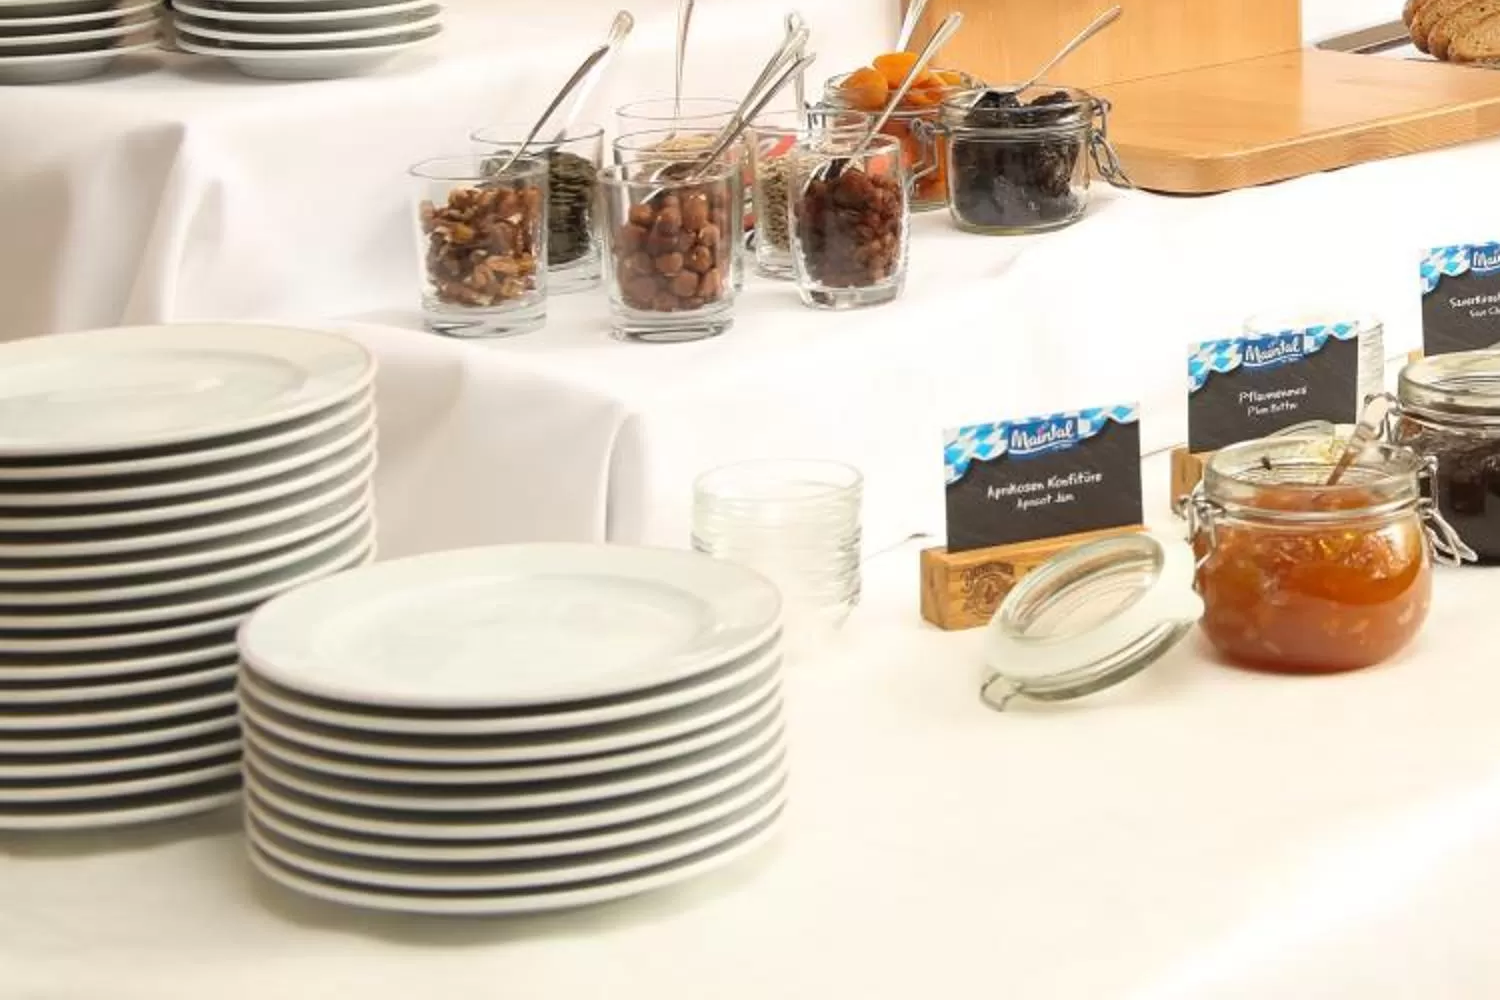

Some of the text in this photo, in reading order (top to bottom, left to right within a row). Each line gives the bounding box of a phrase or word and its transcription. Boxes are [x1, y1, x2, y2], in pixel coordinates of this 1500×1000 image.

[1244, 336, 1300, 363] Maintal
[1011, 419, 1075, 449] Maintal
[987, 471, 1102, 500] Aprikosen Konfitüre
